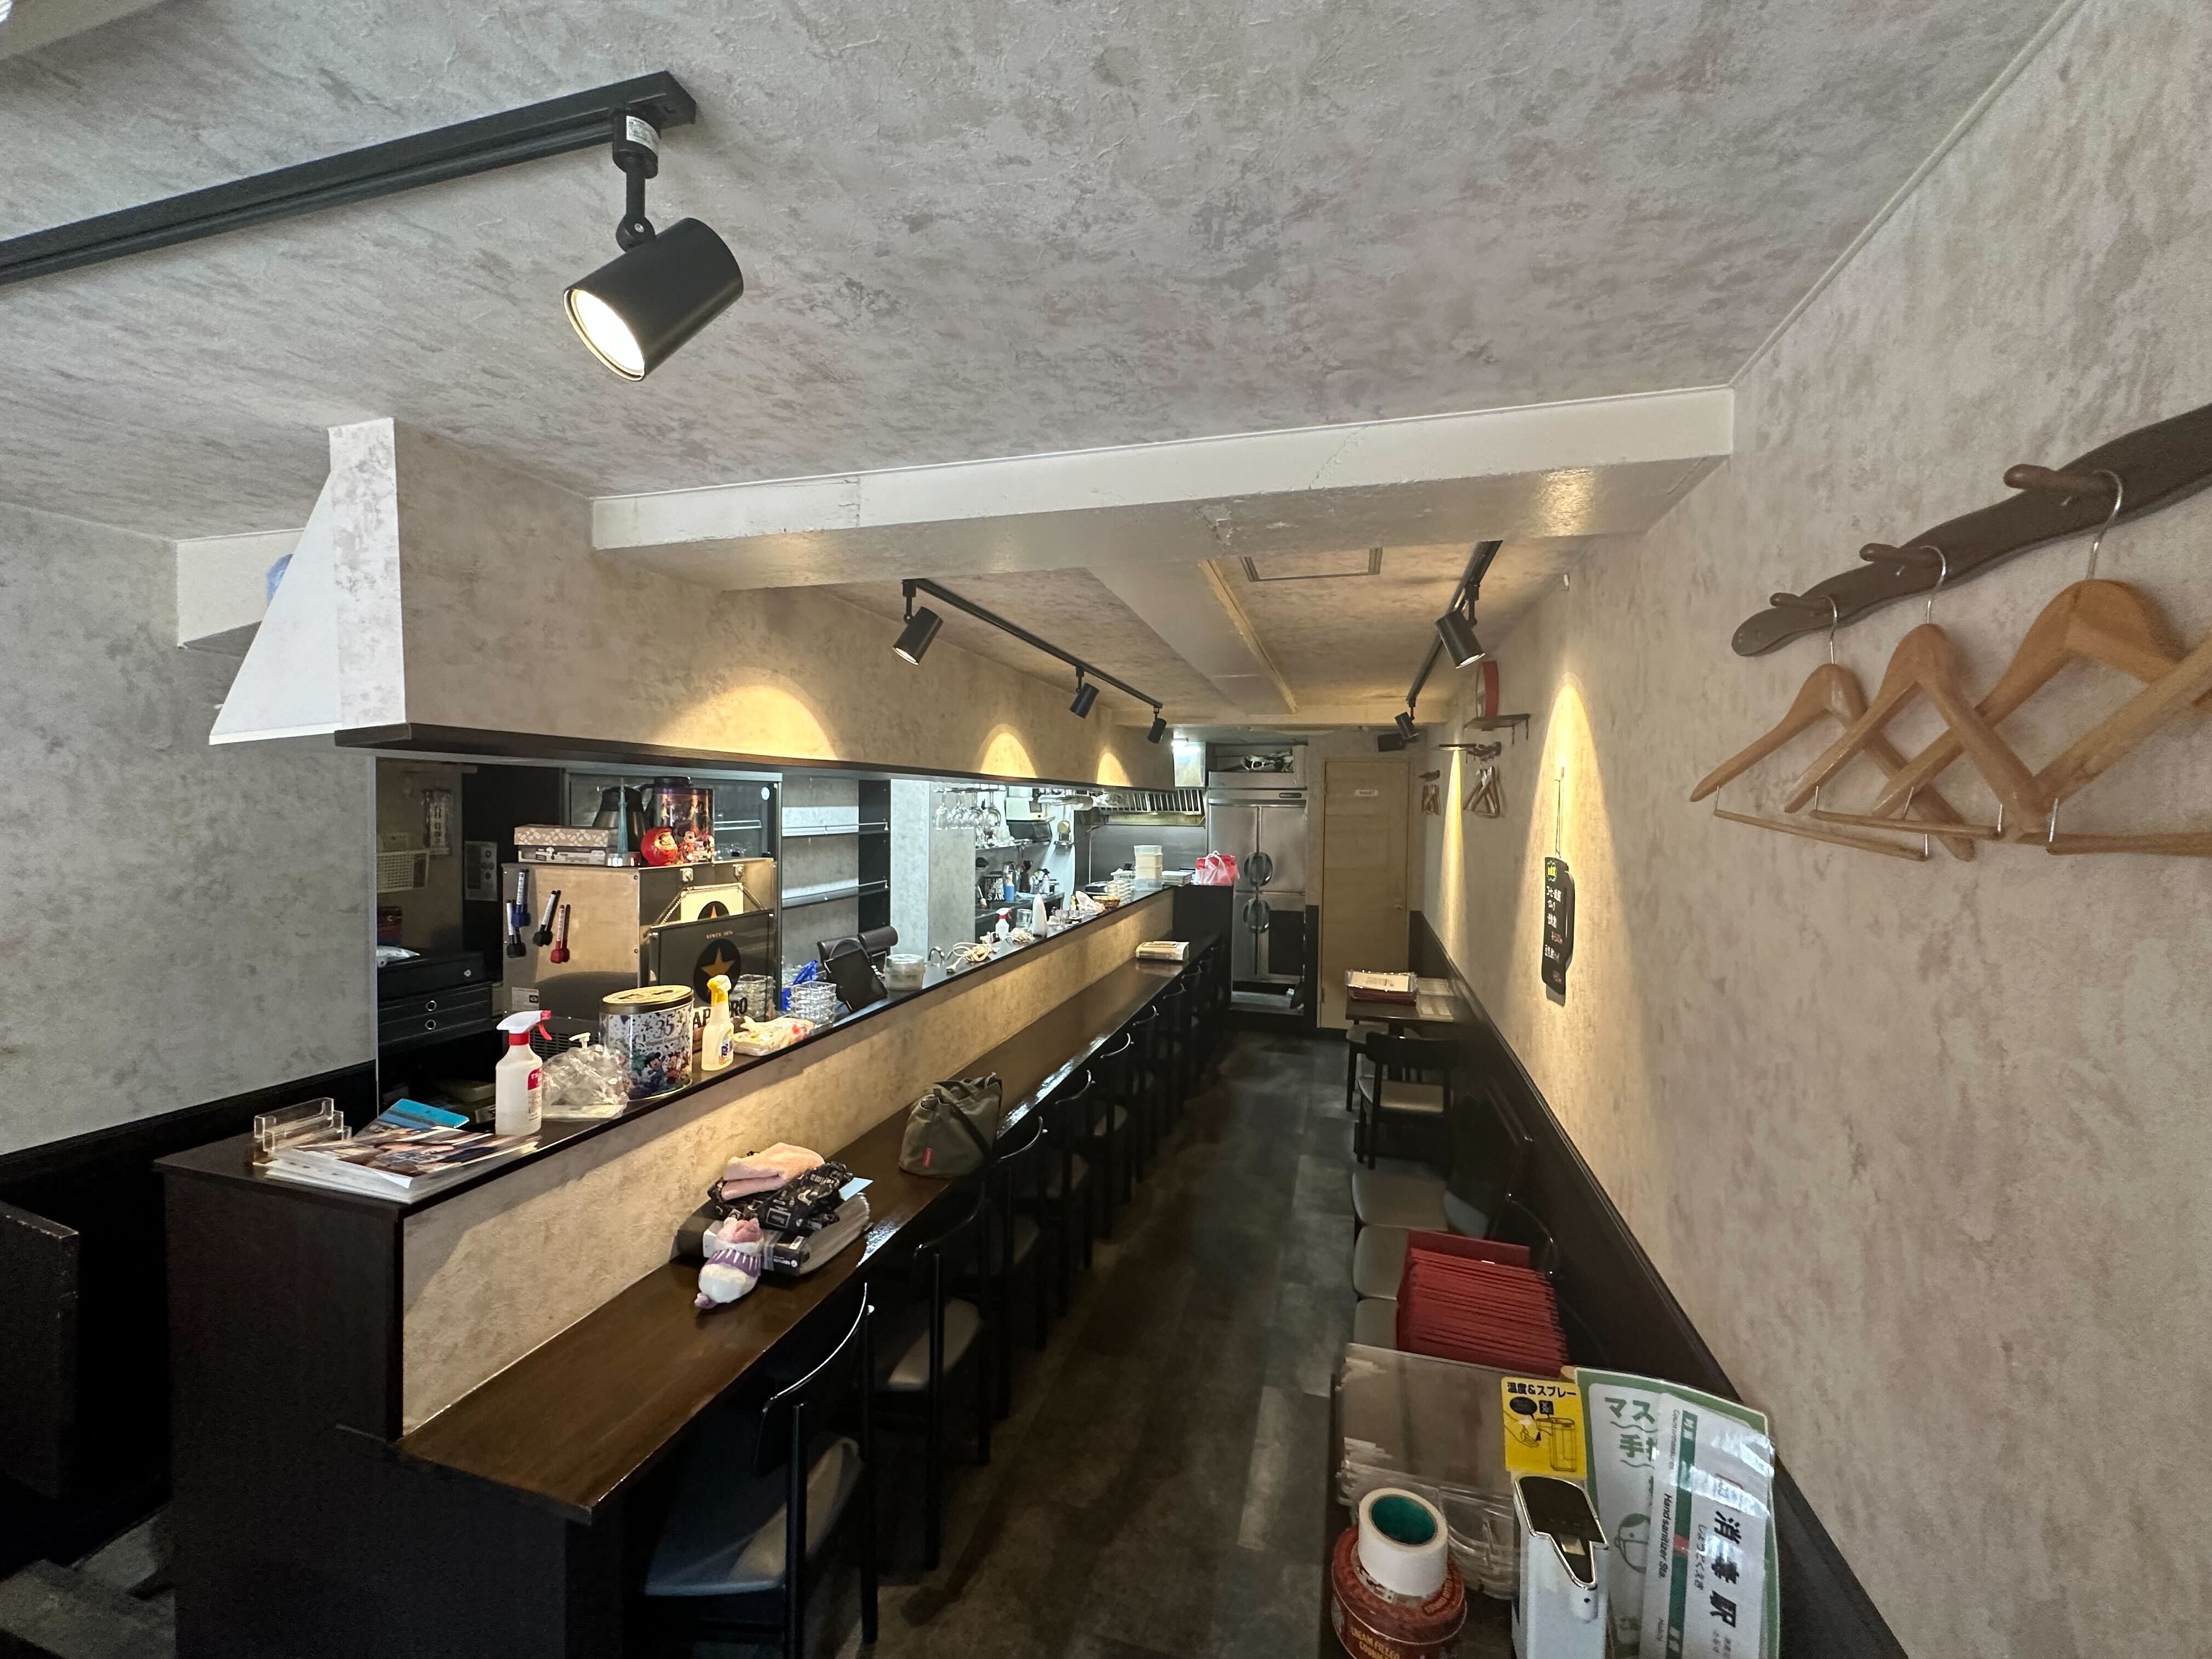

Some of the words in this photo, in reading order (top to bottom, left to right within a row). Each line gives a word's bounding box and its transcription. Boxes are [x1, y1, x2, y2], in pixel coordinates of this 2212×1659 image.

[693, 997, 748, 1028] APRO
[1507, 1381, 1577, 1398] 温度&スプレー
[1662, 1493, 1673, 1520] Hand
[1658, 1520, 1671, 1561] sanitizer
[1658, 1561, 1669, 1579] Sta.
